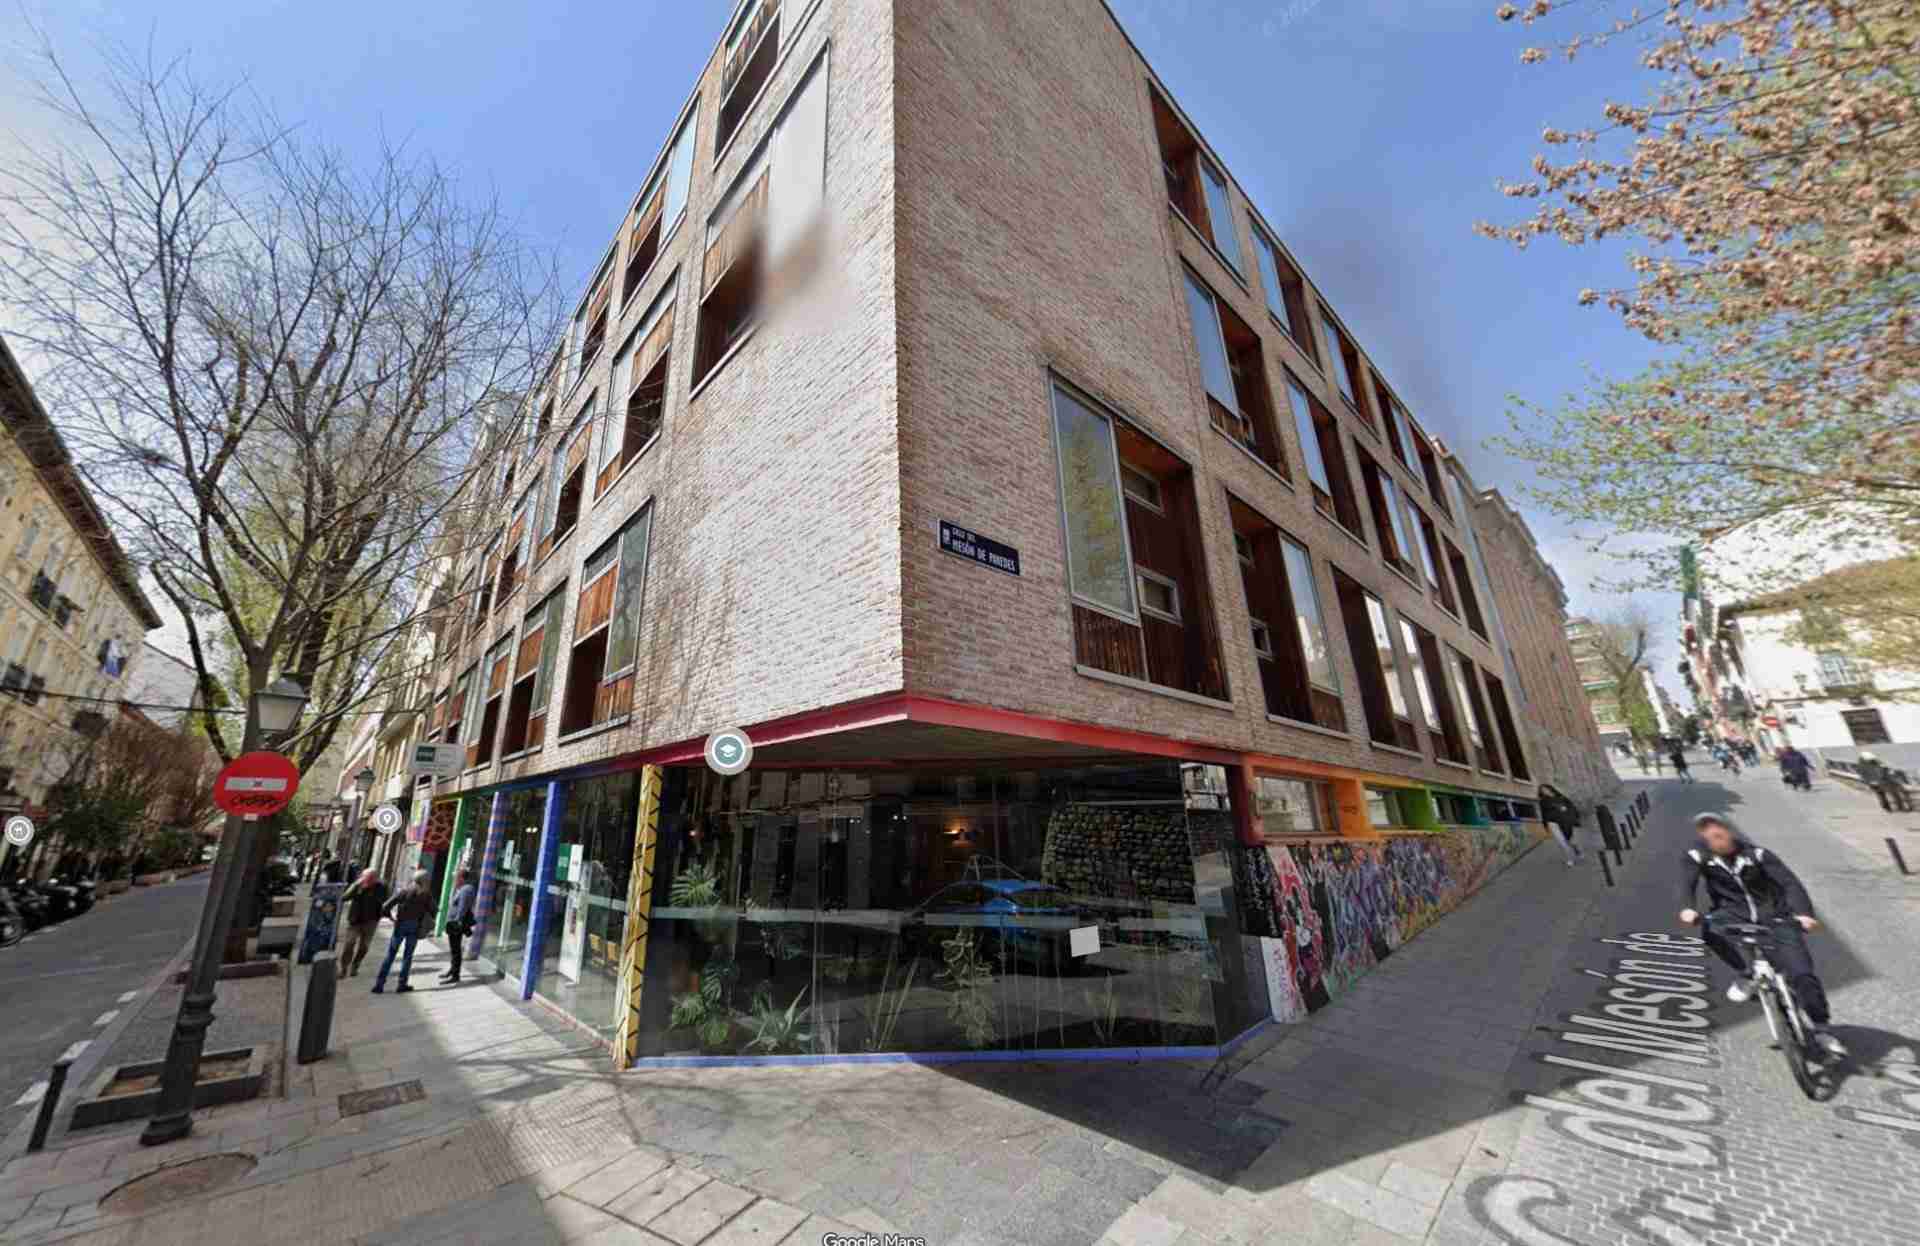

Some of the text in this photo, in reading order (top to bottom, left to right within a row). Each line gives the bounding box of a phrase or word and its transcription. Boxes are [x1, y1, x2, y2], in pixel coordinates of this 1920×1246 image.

[952, 539, 1015, 572] MESÓN DE PAREDES
